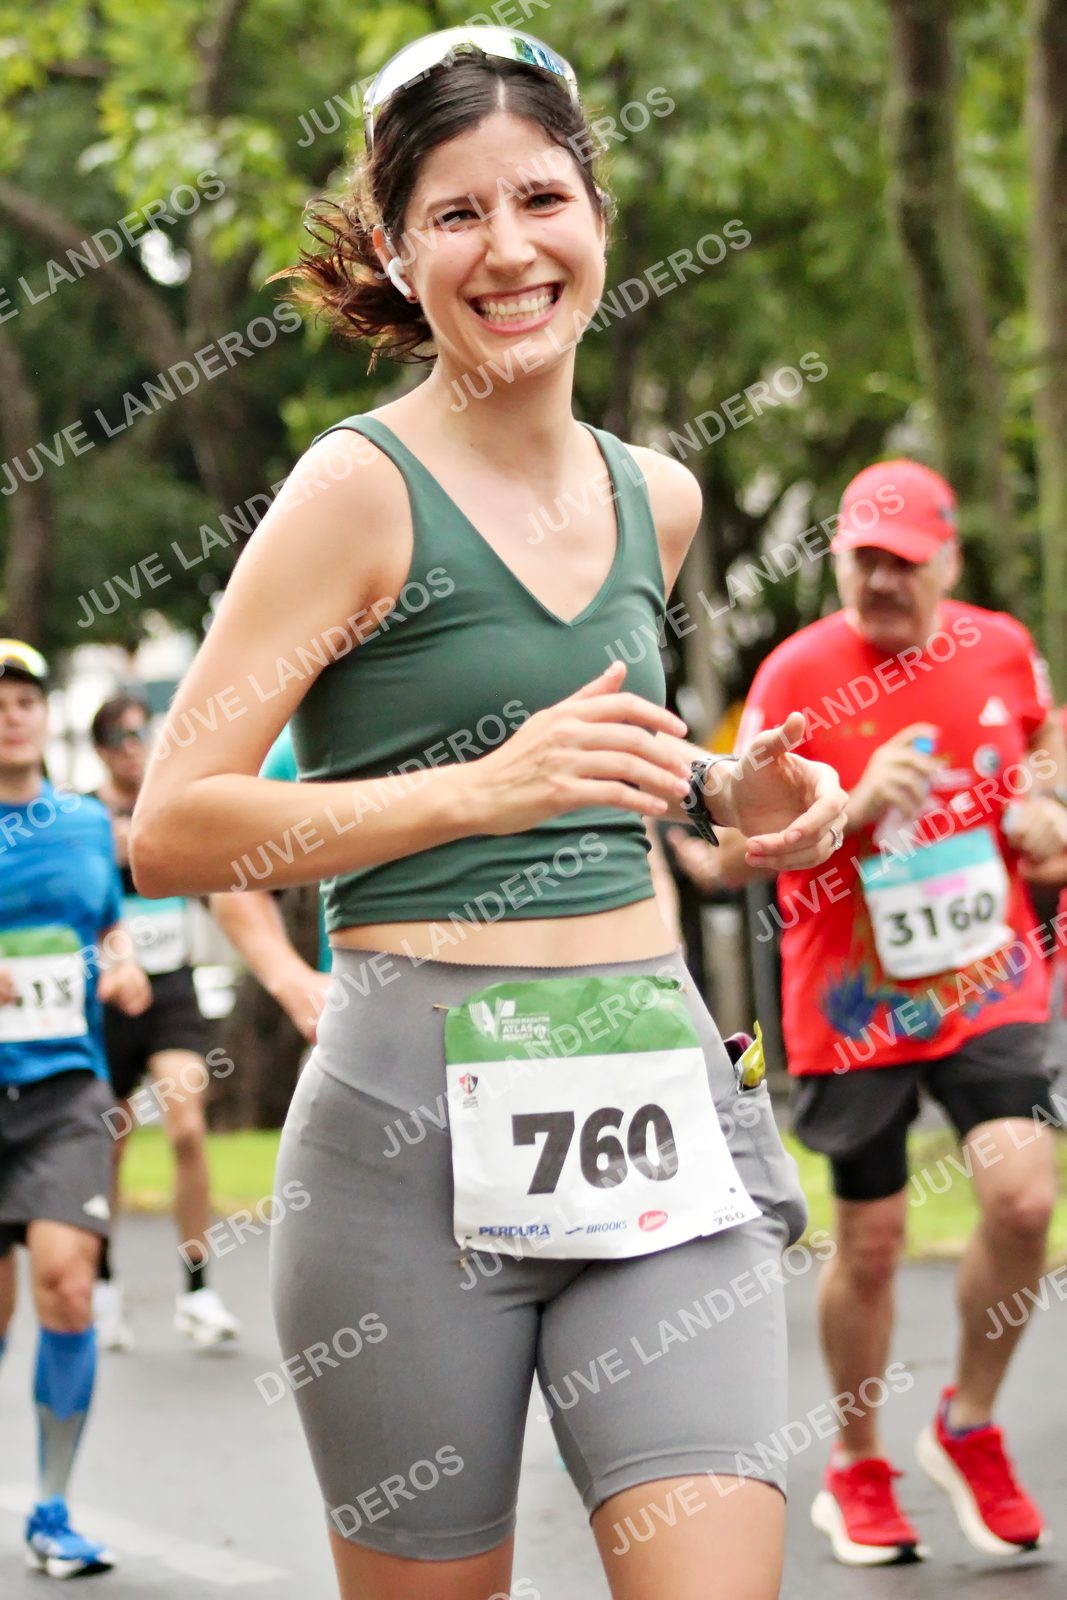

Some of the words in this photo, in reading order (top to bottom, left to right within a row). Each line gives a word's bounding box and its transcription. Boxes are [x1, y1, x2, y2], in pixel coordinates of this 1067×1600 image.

[886, 888, 996, 947] 3160
[512, 1103, 679, 1194] 760
[713, 1211, 746, 1226] 760
[479, 1223, 551, 1237] PERDURA
[586, 1220, 628, 1234] BROOKS
